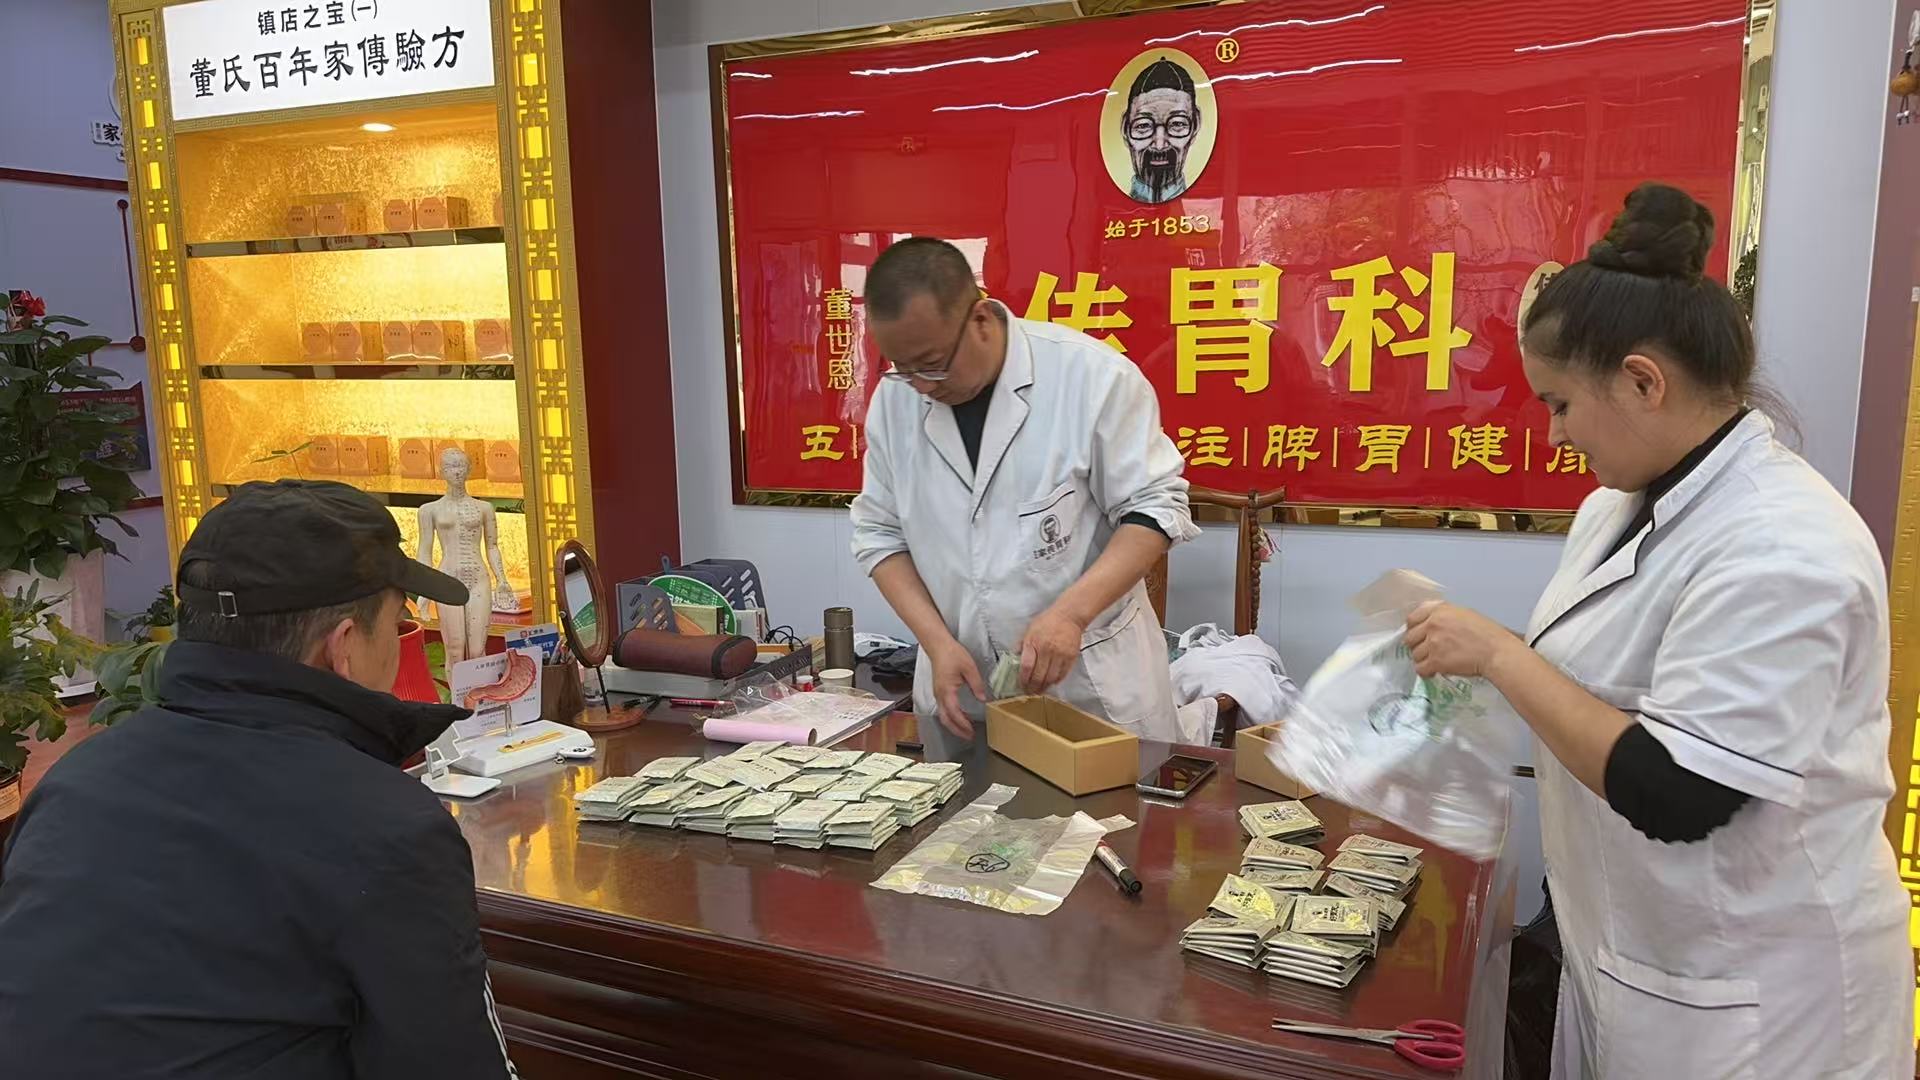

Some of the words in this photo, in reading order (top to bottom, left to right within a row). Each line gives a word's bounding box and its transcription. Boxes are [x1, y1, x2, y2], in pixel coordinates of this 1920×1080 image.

[189, 25, 465, 98] 董氏百年家傳驗方
[102, 122, 123, 142] 家
[1104, 214, 1211, 239] 始于1853
[823, 287, 855, 390] 董世恩
[980, 251, 1473, 395] 传胃科
